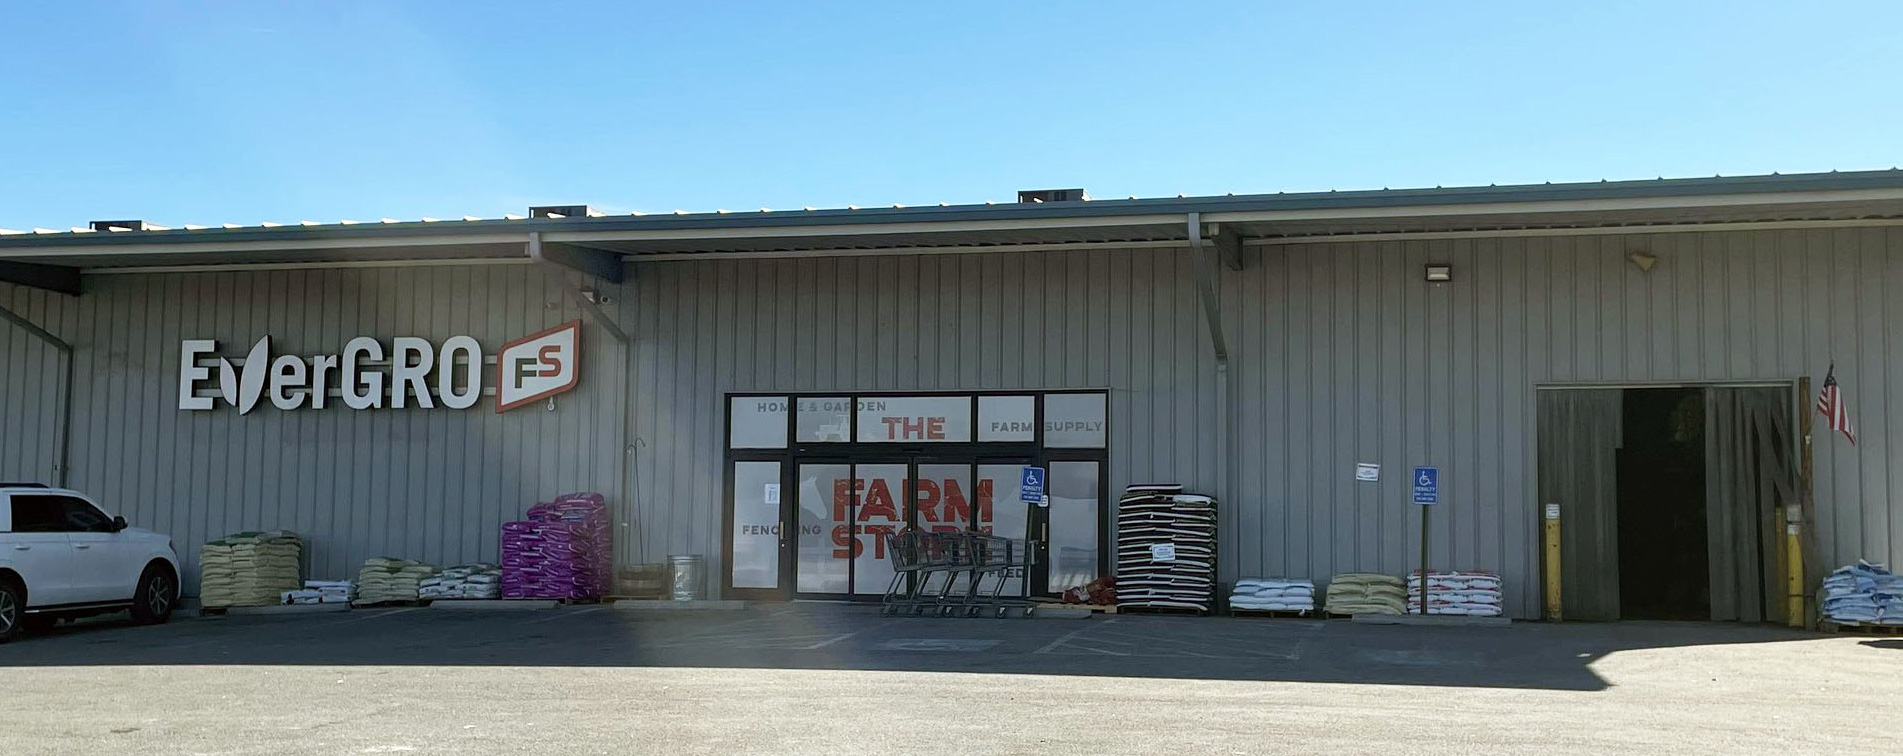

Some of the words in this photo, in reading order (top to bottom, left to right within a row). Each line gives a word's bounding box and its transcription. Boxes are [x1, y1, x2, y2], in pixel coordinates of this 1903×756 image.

[179, 335, 482, 415] EverGRO
[515, 345, 561, 389] FS
[757, 402, 804, 413] HOME
[823, 401, 886, 412] GARDEN
[881, 416, 946, 440] THE
[991, 421, 1033, 432] FARM
[1044, 421, 1103, 432] SUPPLY
[833, 478, 994, 522] FARM
[742, 524, 822, 536] FENCNG
